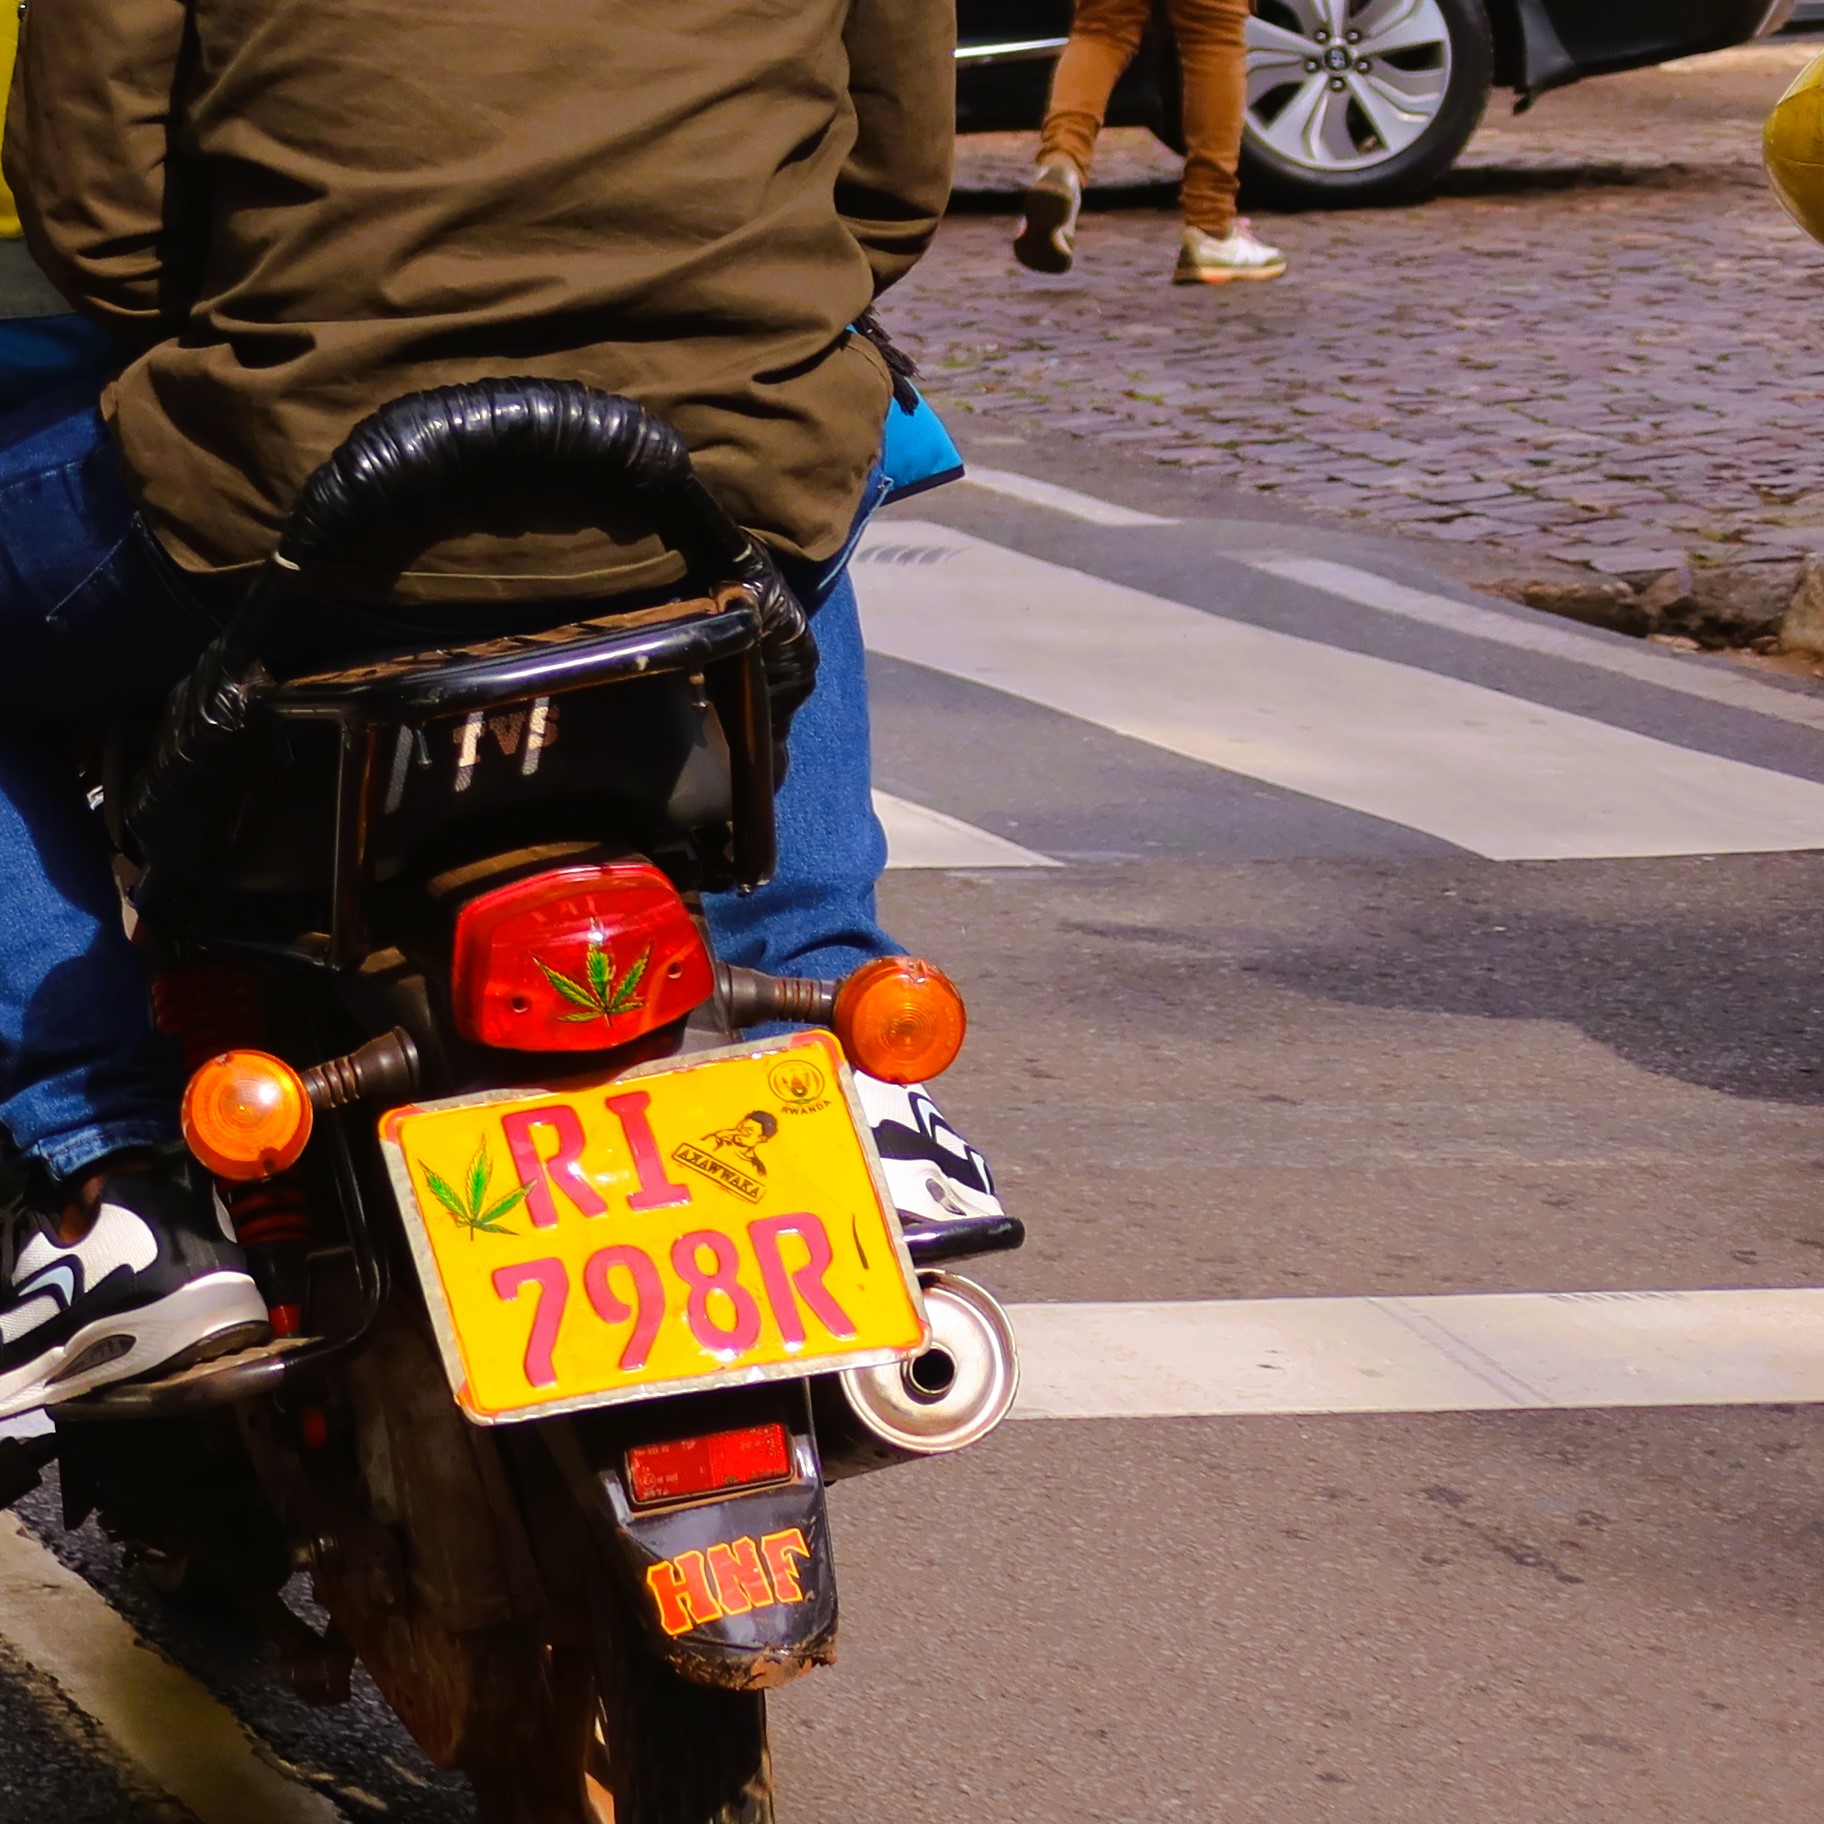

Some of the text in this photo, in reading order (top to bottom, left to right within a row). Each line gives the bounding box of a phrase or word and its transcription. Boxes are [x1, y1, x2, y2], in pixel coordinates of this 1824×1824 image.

[501, 1090, 693, 1229] RI
[781, 1100, 832, 1116] RWANDA
[492, 1211, 858, 1390] 798R
[646, 1528, 811, 1636] HNF
